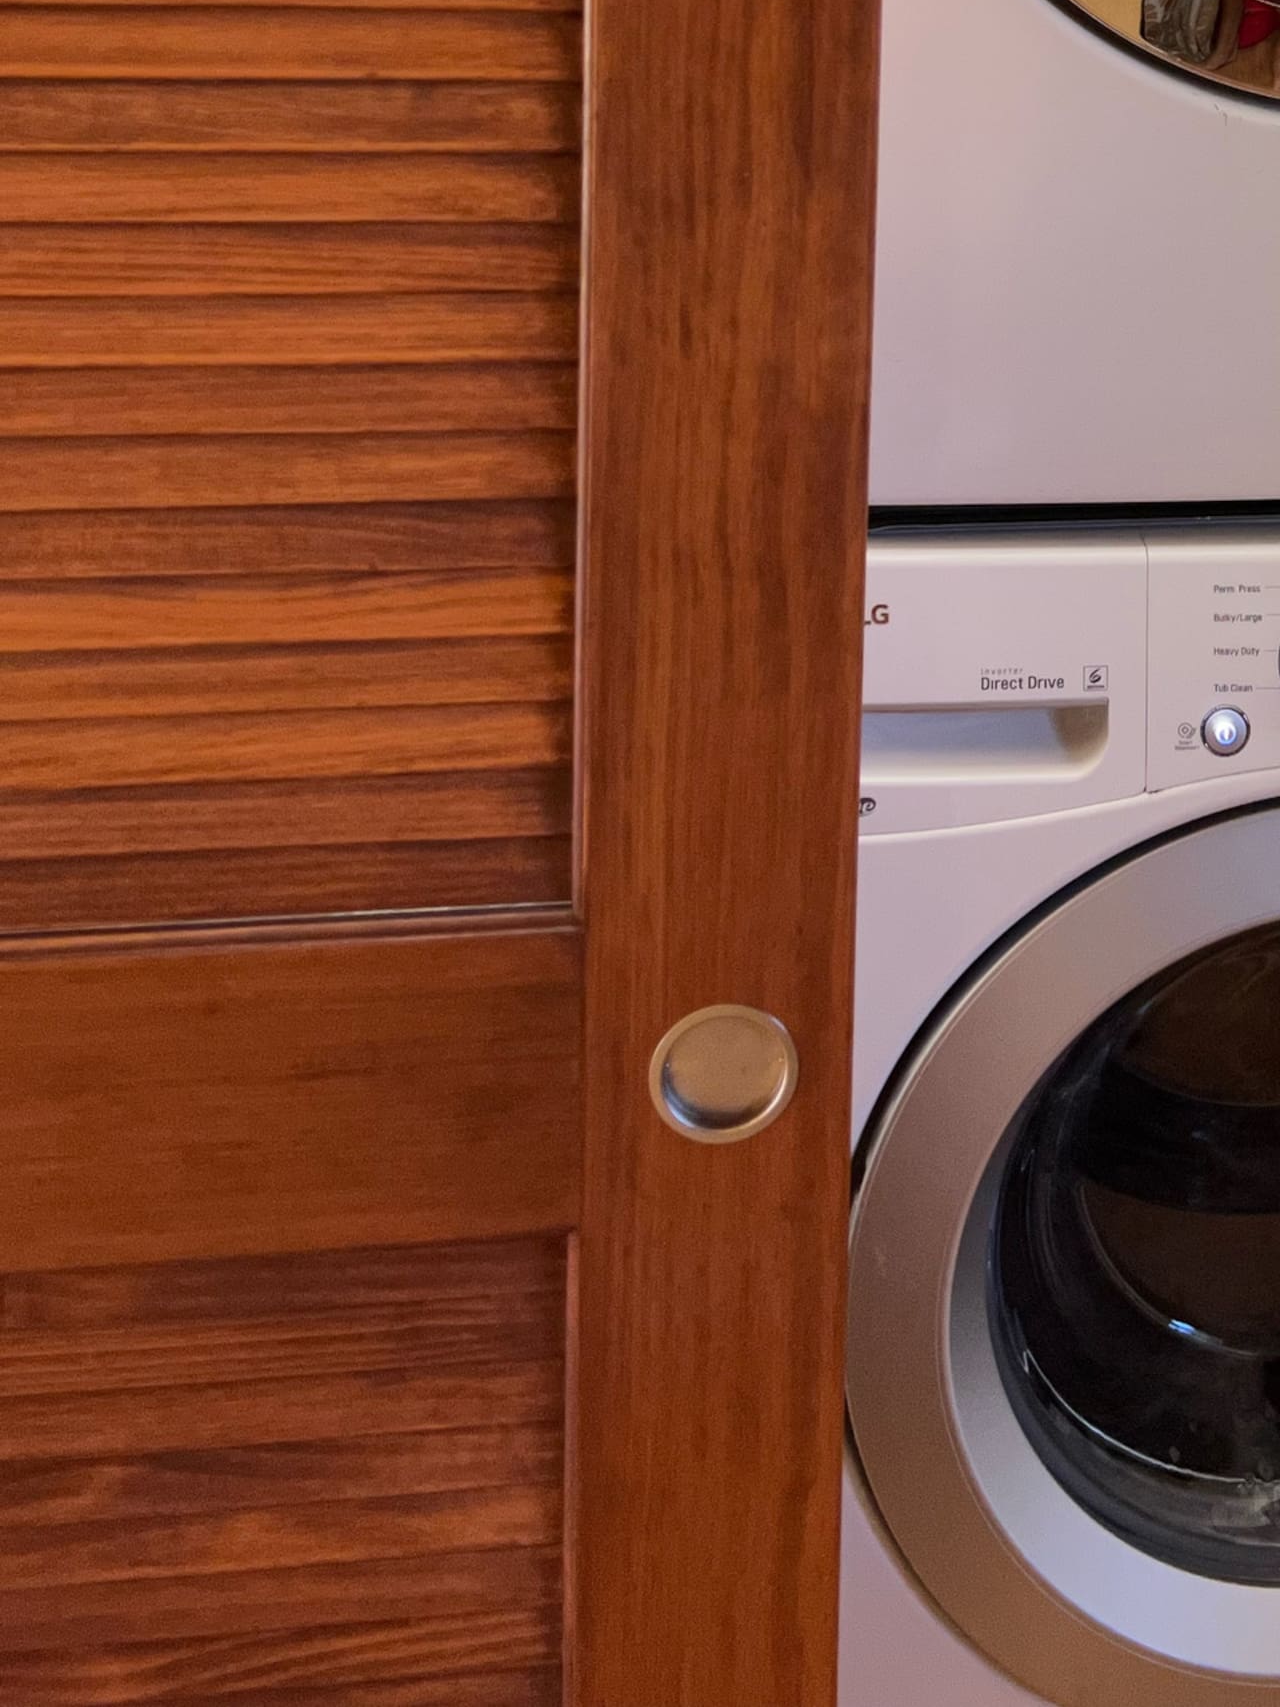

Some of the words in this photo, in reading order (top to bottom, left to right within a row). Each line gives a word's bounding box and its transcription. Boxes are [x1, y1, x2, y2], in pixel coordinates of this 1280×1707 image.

[1238, 584, 1261, 594] Press
[1213, 613, 1263, 623] Bulky/Large
[1213, 647, 1240, 657] Heavy
[1241, 647, 1260, 657] Duty
[980, 676, 1024, 691] Direct
[1027, 675, 1065, 690] Drive
[1214, 683, 1229, 693] Tub
[1230, 683, 1253, 693] Clean
